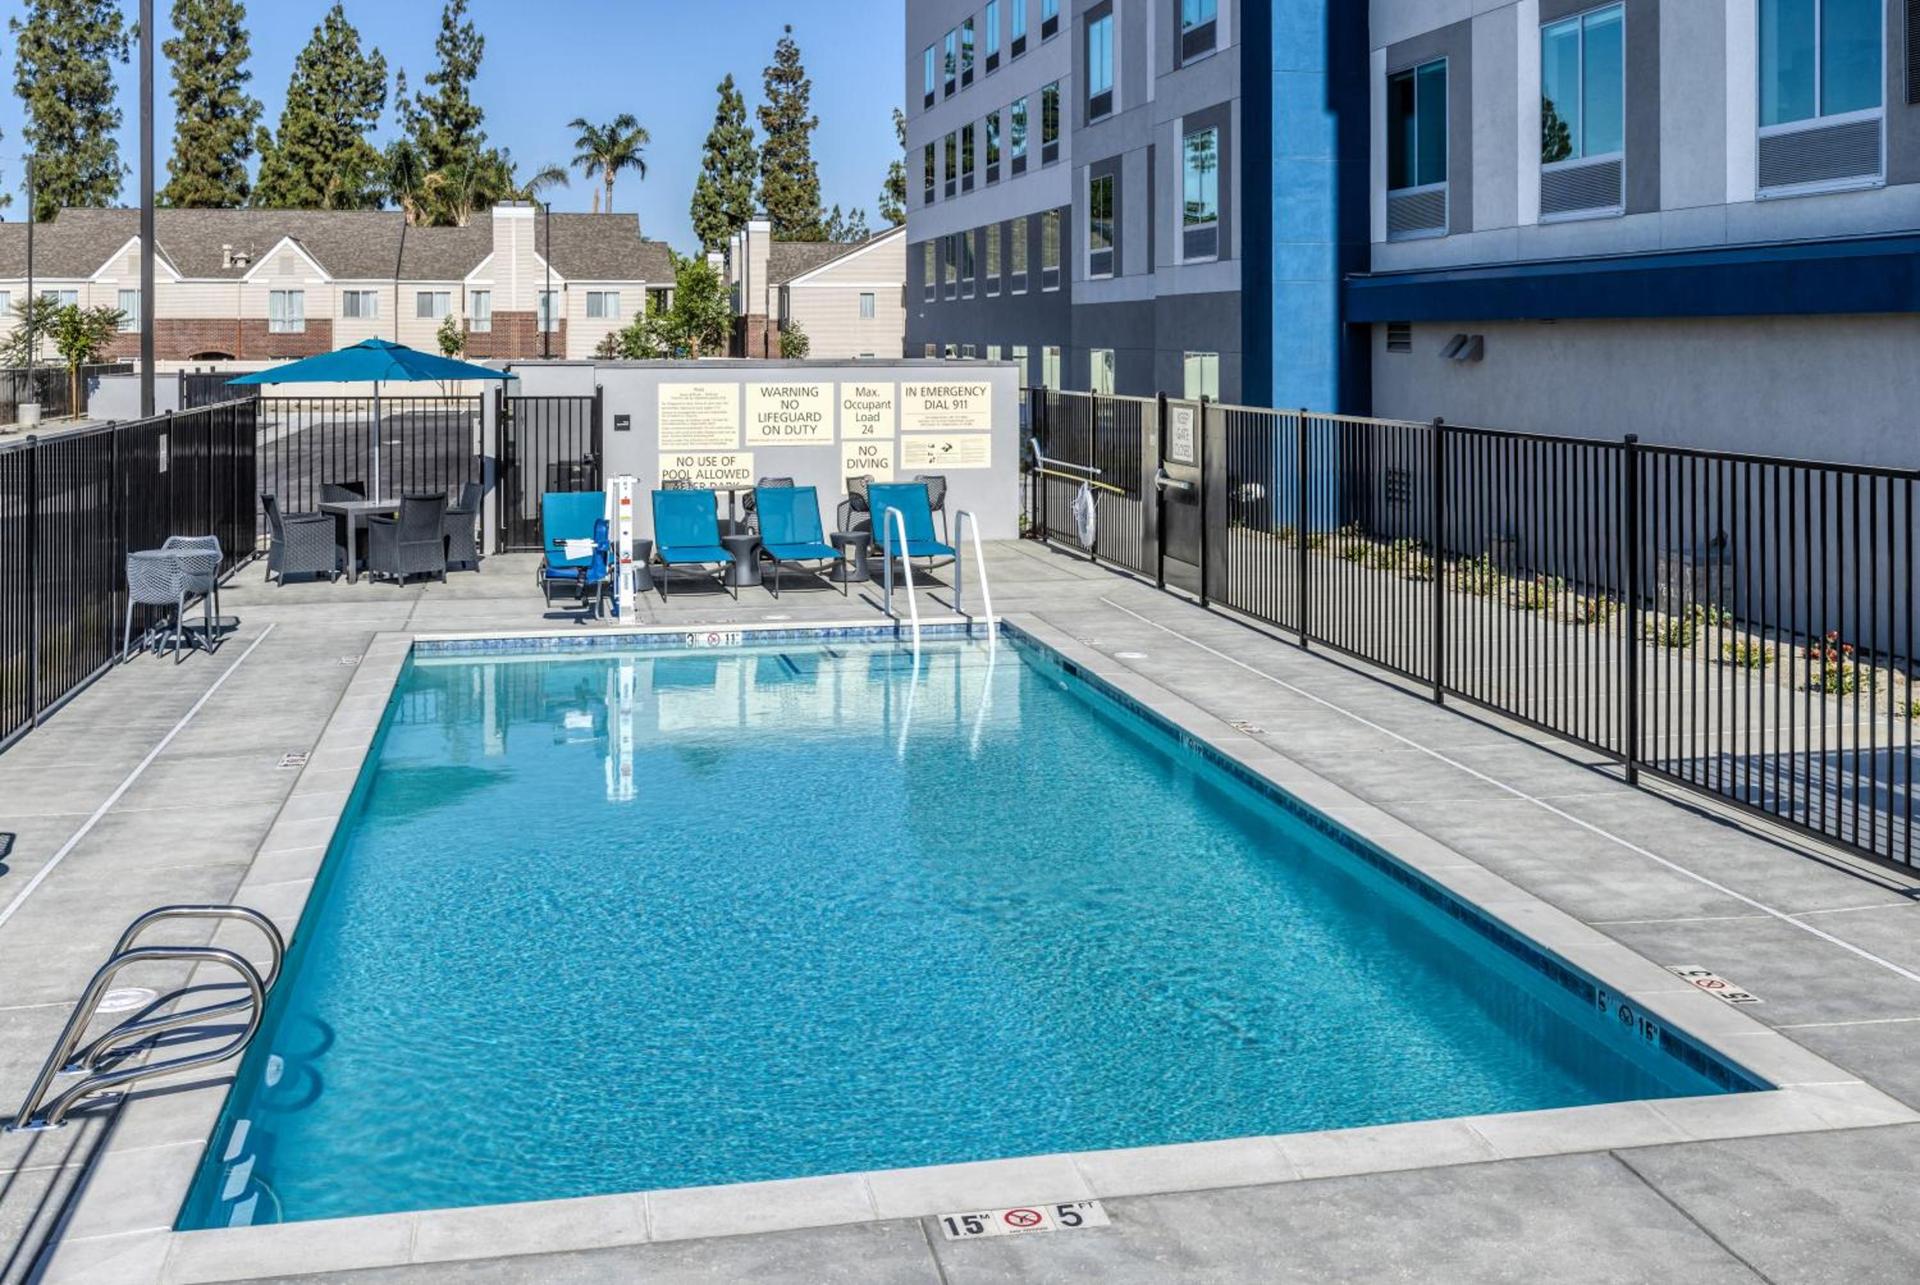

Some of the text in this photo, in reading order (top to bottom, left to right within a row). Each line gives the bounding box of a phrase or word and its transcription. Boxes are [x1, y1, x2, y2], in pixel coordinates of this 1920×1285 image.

[760, 387, 819, 398] WARNING
[855, 387, 880, 397] Max.
[905, 386, 986, 397] IN EMERGENCY
[780, 400, 799, 410] NO
[843, 400, 892, 411] Occupant
[924, 399, 968, 410] DIAL 911
[758, 412, 822, 423] LIFEGUARD
[855, 412, 880, 422] Load
[762, 425, 818, 435] ON DUTY
[861, 424, 874, 435] 24
[858, 446, 877, 456] NO
[676, 456, 736, 467] NO USE OF
[846, 458, 889, 469] DIVING
[662, 469, 750, 480] POOL ALLOWED
